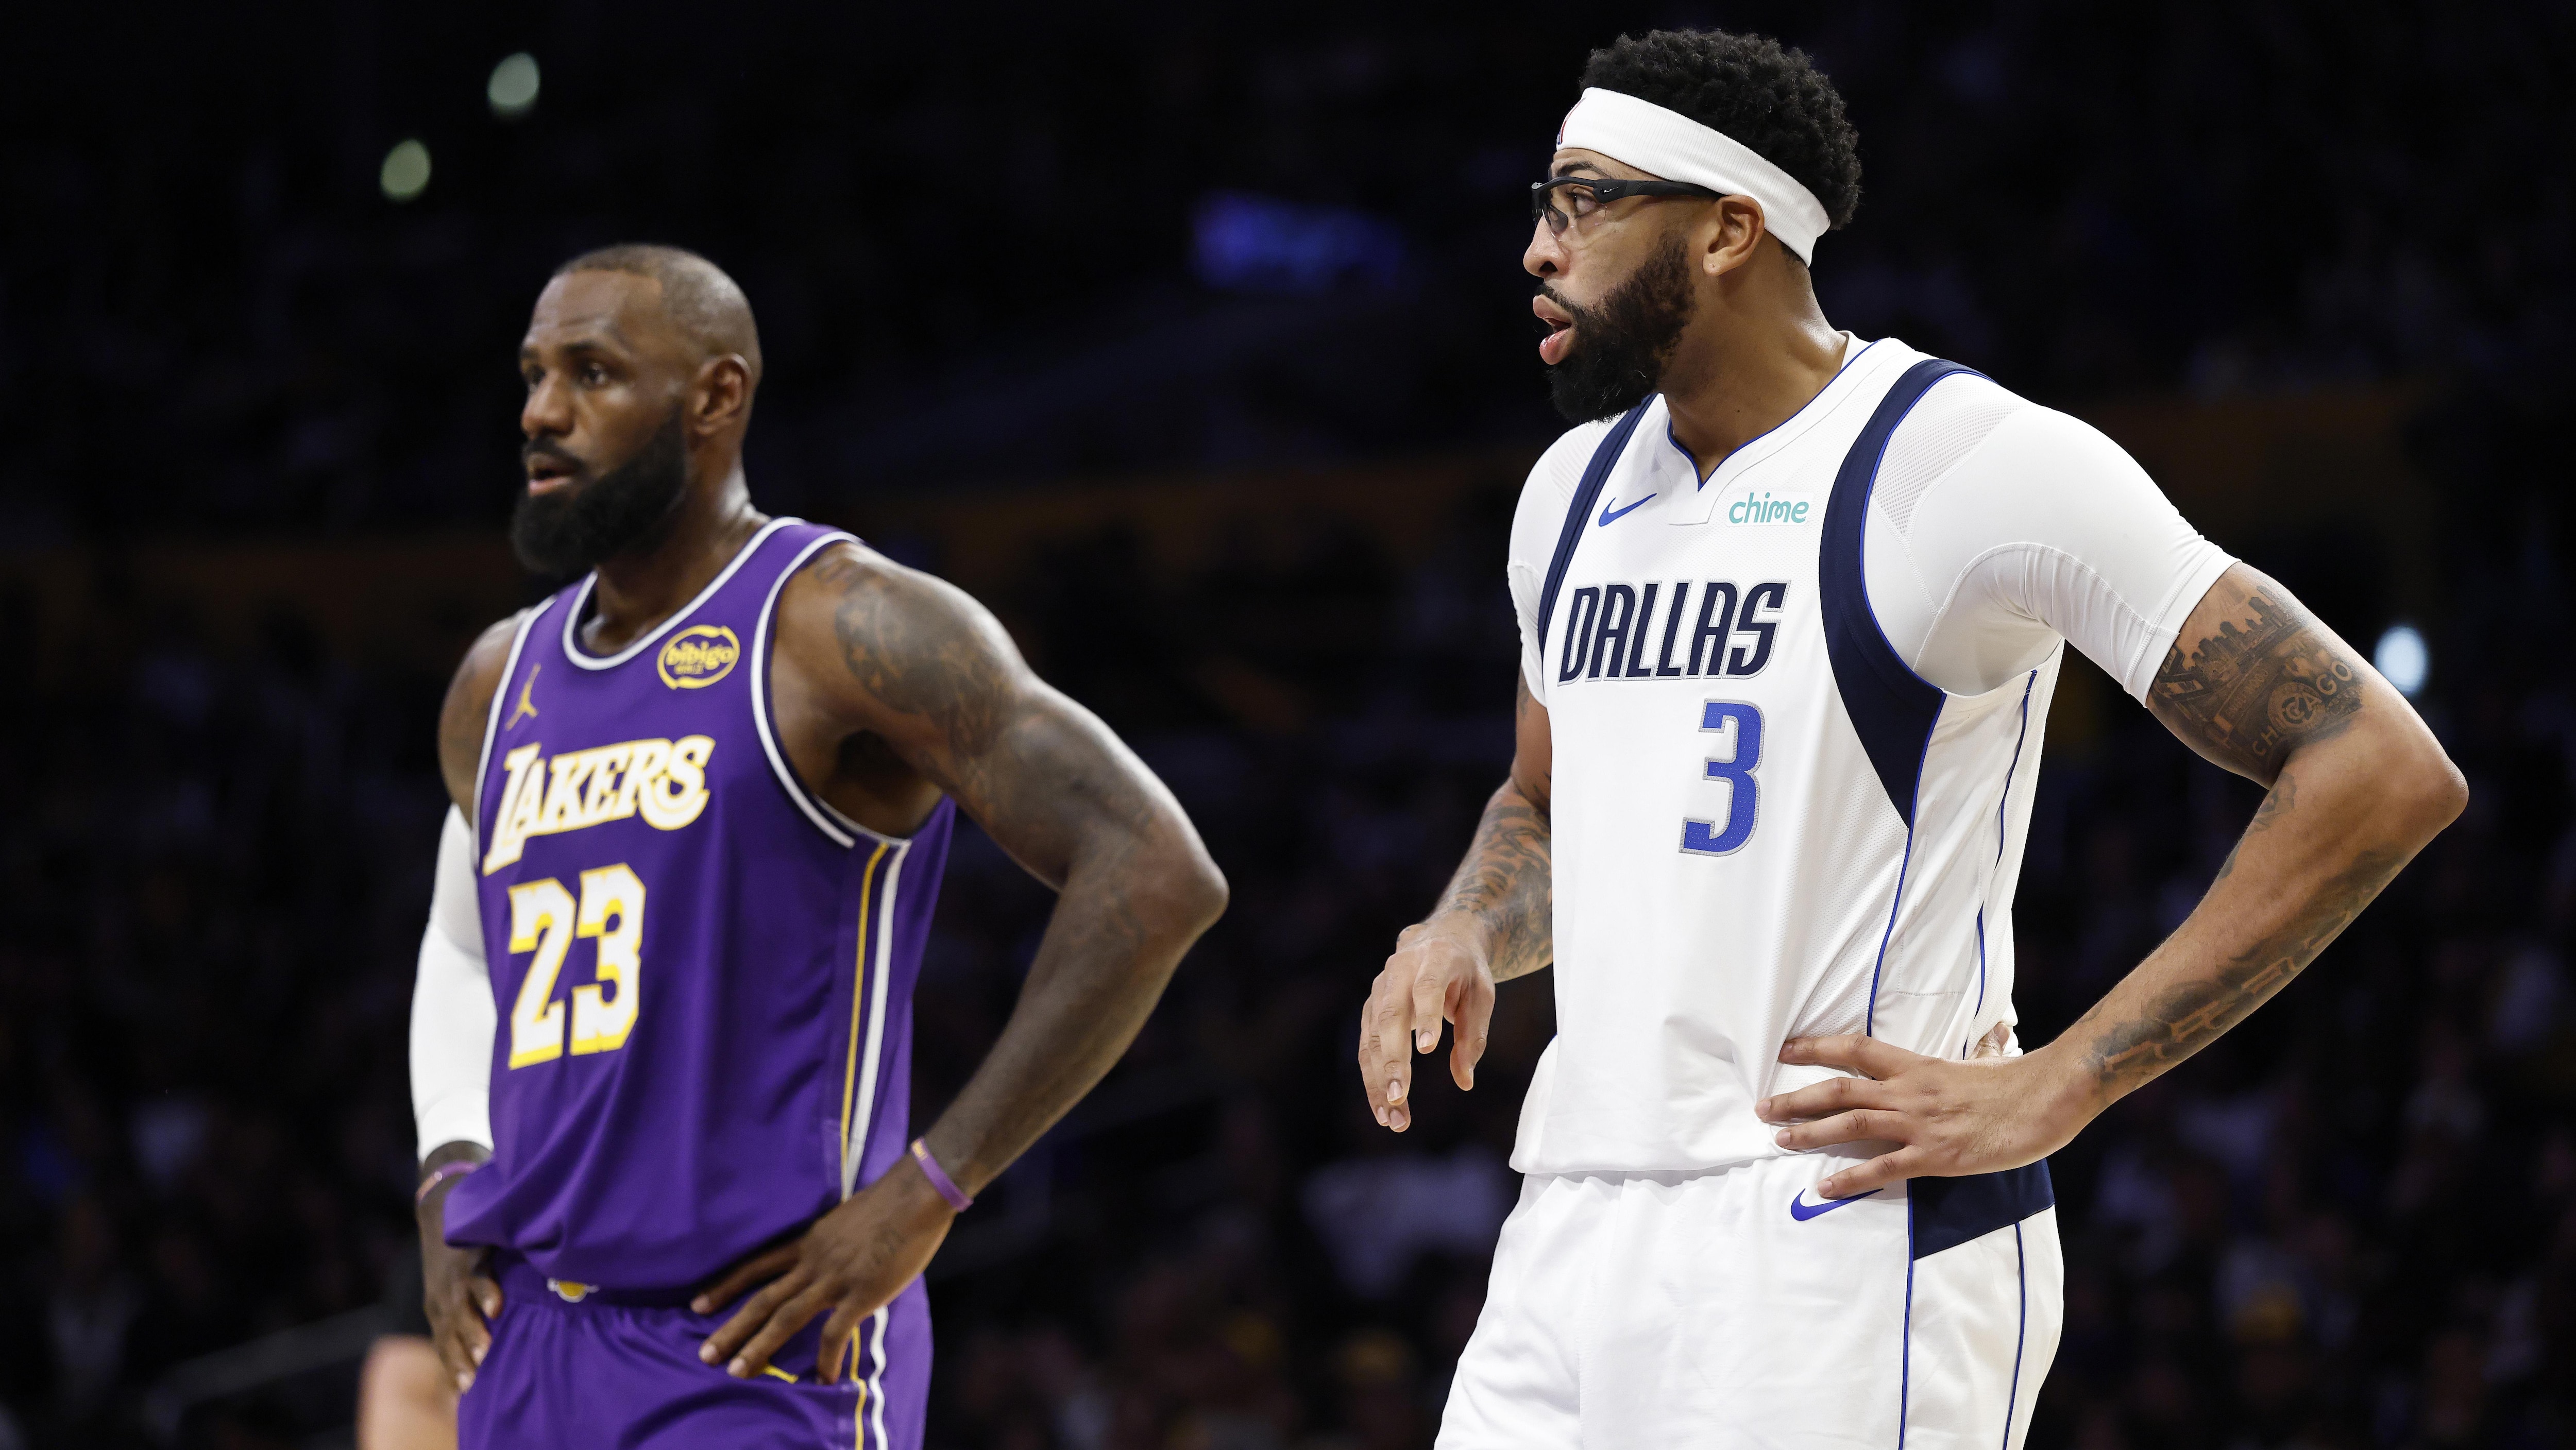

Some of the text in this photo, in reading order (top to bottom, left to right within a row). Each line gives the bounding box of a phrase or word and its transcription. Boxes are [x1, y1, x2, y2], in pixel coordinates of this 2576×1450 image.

[1728, 492, 1809, 524] chime
[665, 640, 734, 670] bibigo
[1557, 578, 1791, 687] DALLAS
[2252, 660, 2352, 756] CHICAGO
[482, 734, 716, 877] LAKERS
[1679, 698, 1765, 857] 3
[507, 862, 647, 1070] 23
